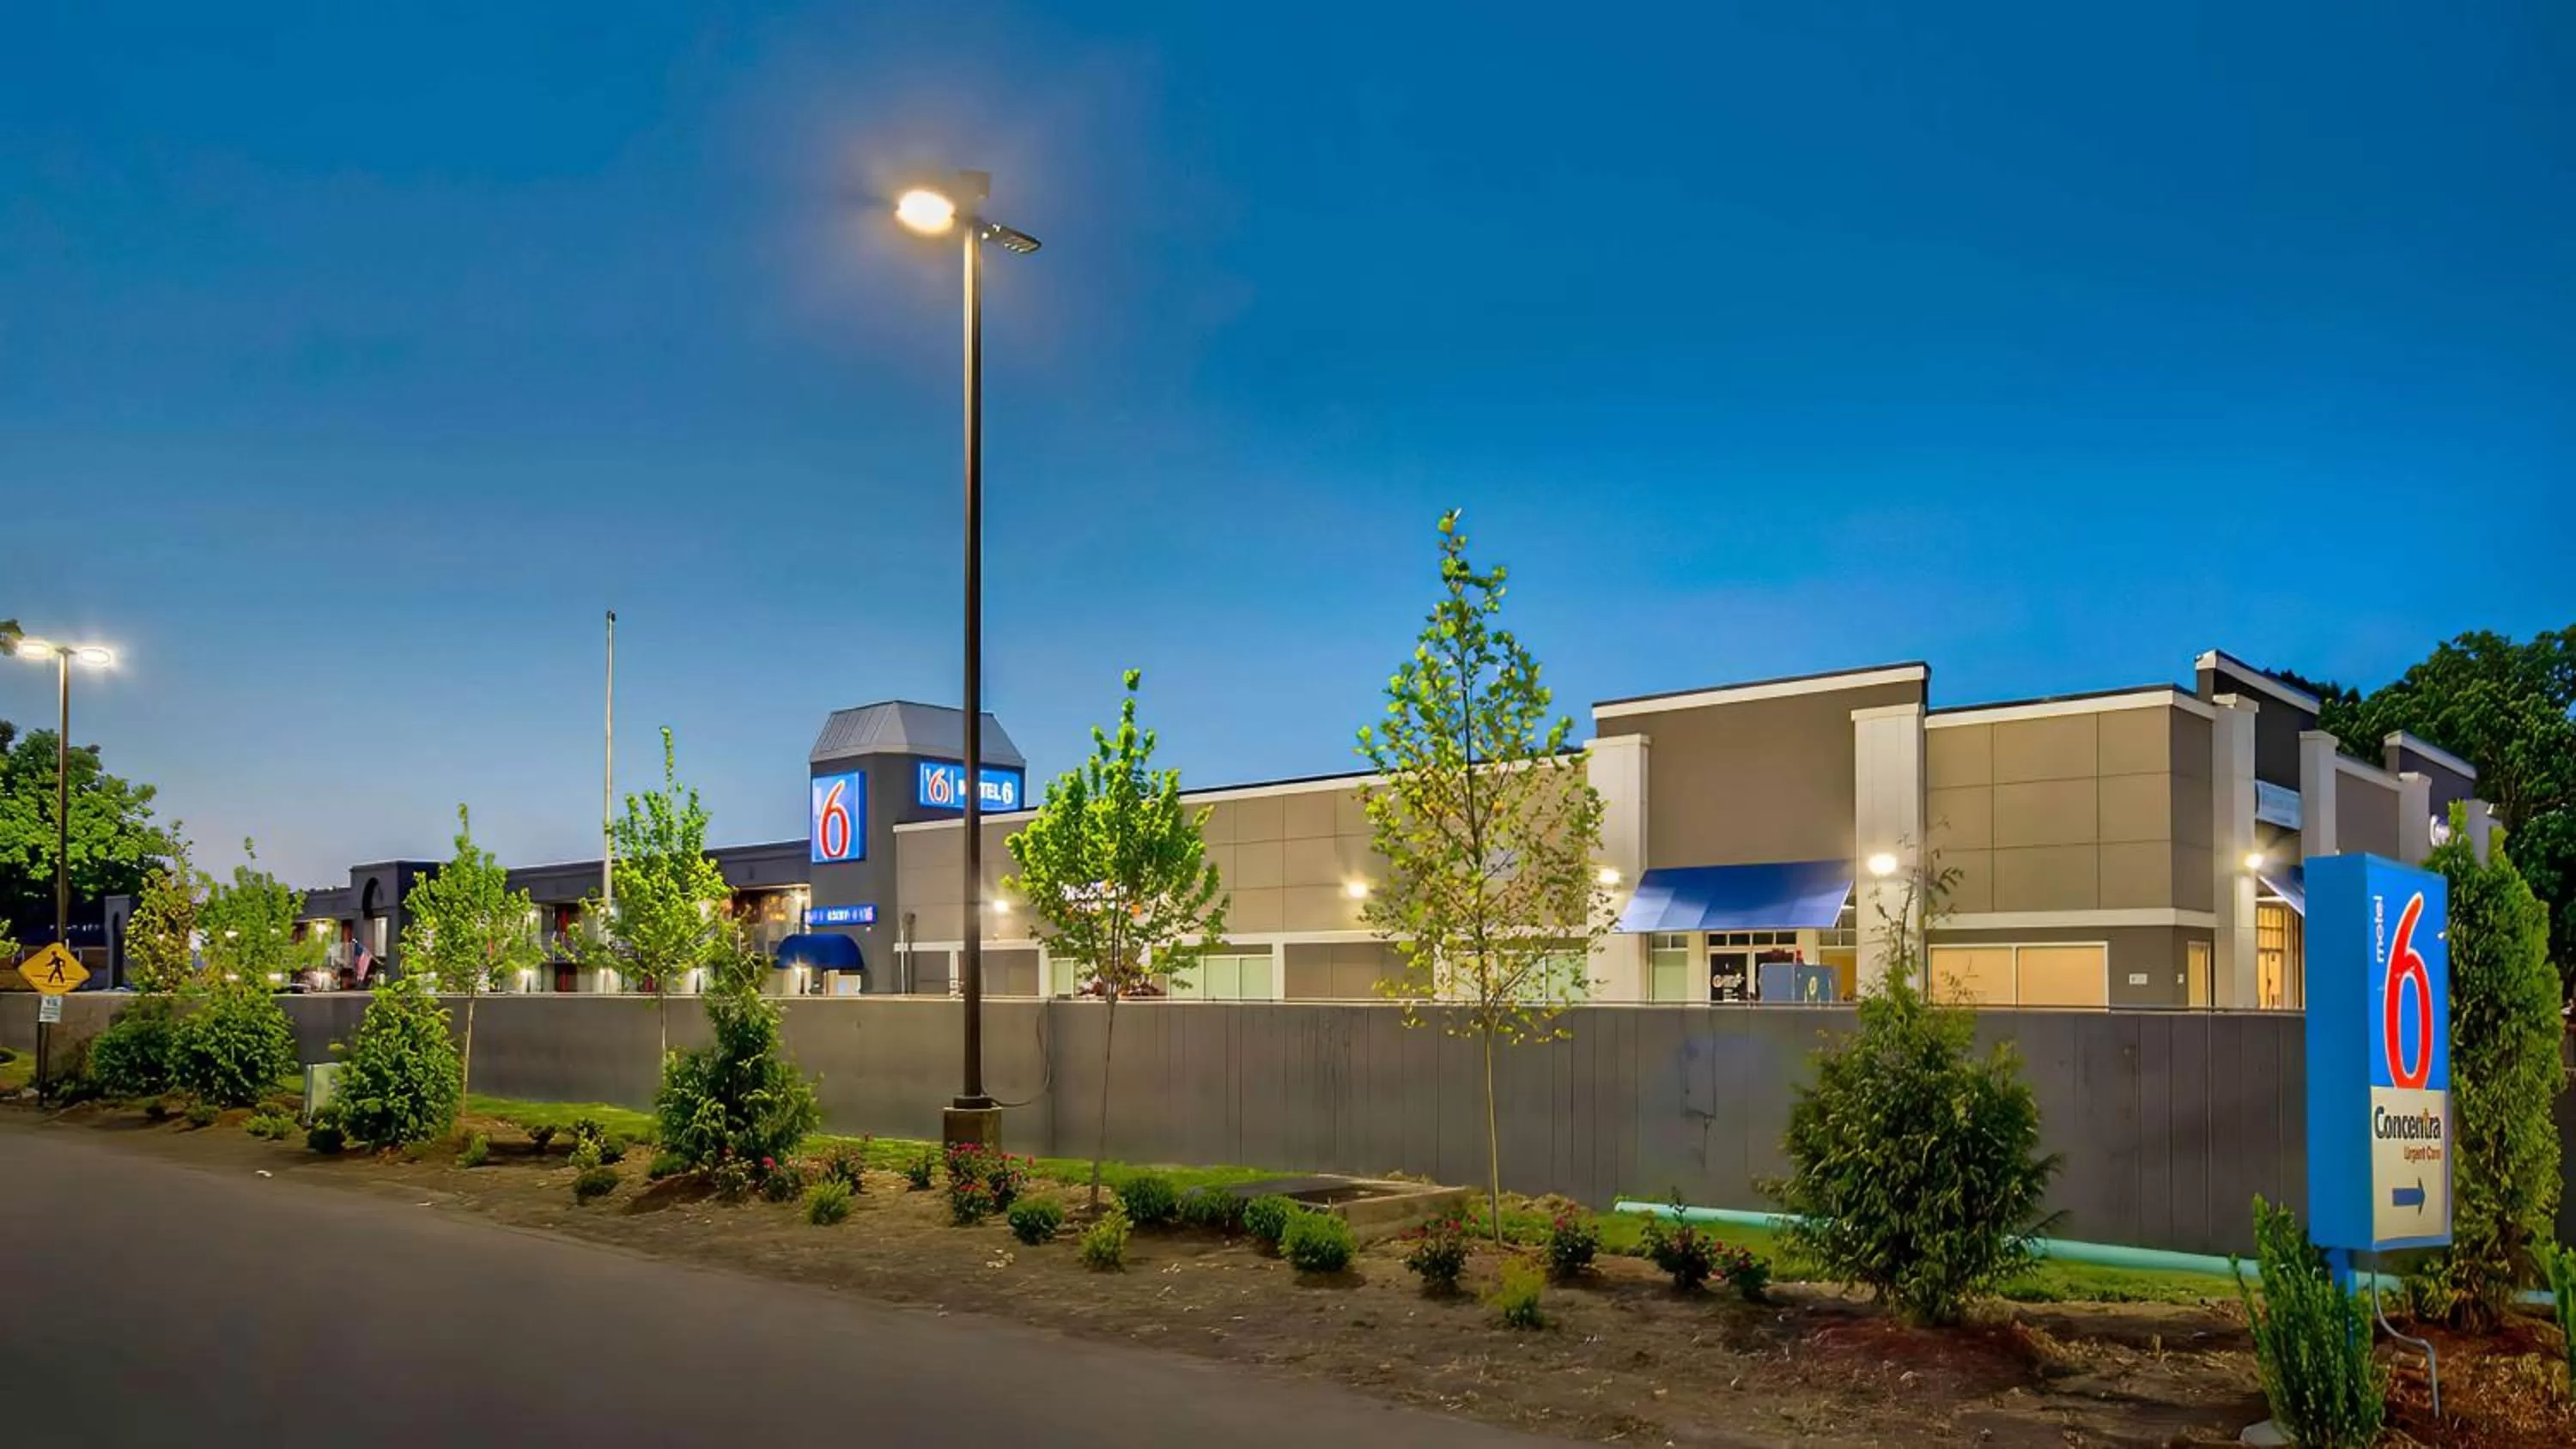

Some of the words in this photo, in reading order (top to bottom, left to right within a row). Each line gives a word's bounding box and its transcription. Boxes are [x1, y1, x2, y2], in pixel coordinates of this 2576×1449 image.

[928, 768, 949, 804] 6
[1002, 782, 1013, 804] 6
[819, 779, 851, 859] 6
[2373, 895, 2385, 962] motel
[2384, 891, 2433, 1090] 6
[2374, 1106, 2441, 1139] Concentra
